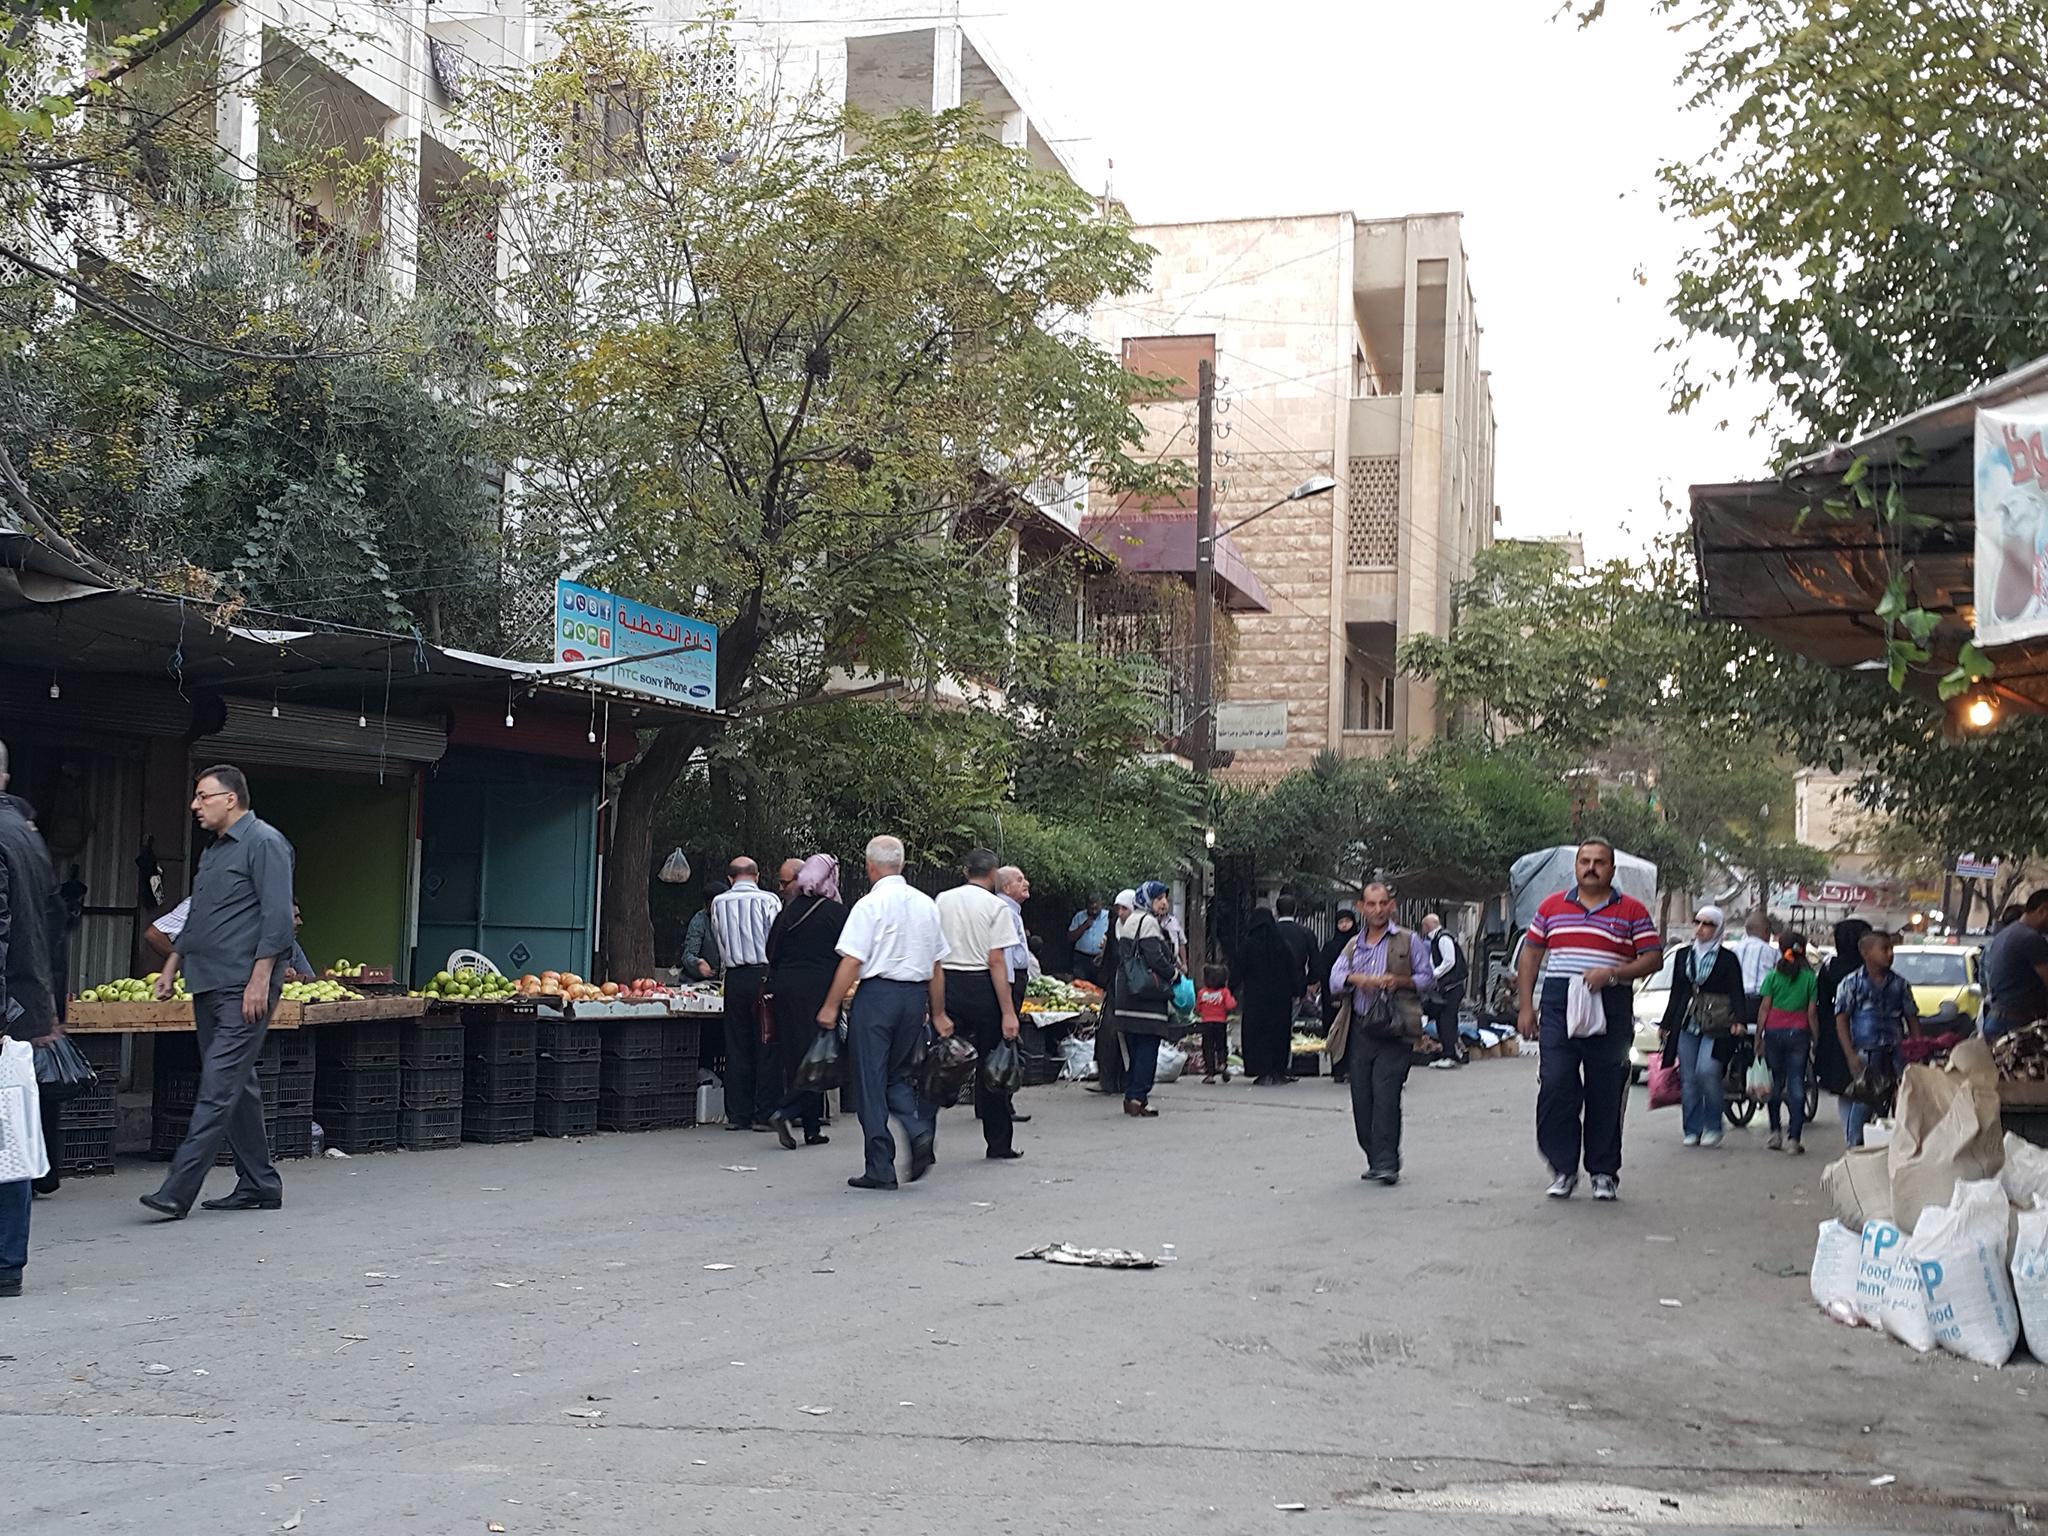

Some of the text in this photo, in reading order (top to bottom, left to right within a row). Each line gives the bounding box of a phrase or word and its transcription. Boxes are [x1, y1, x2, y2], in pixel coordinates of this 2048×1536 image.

[618, 604, 681, 644] التغطية
[684, 629, 712, 652] خارج
[639, 673, 664, 688] SONY
[663, 675, 688, 695] iPhone
